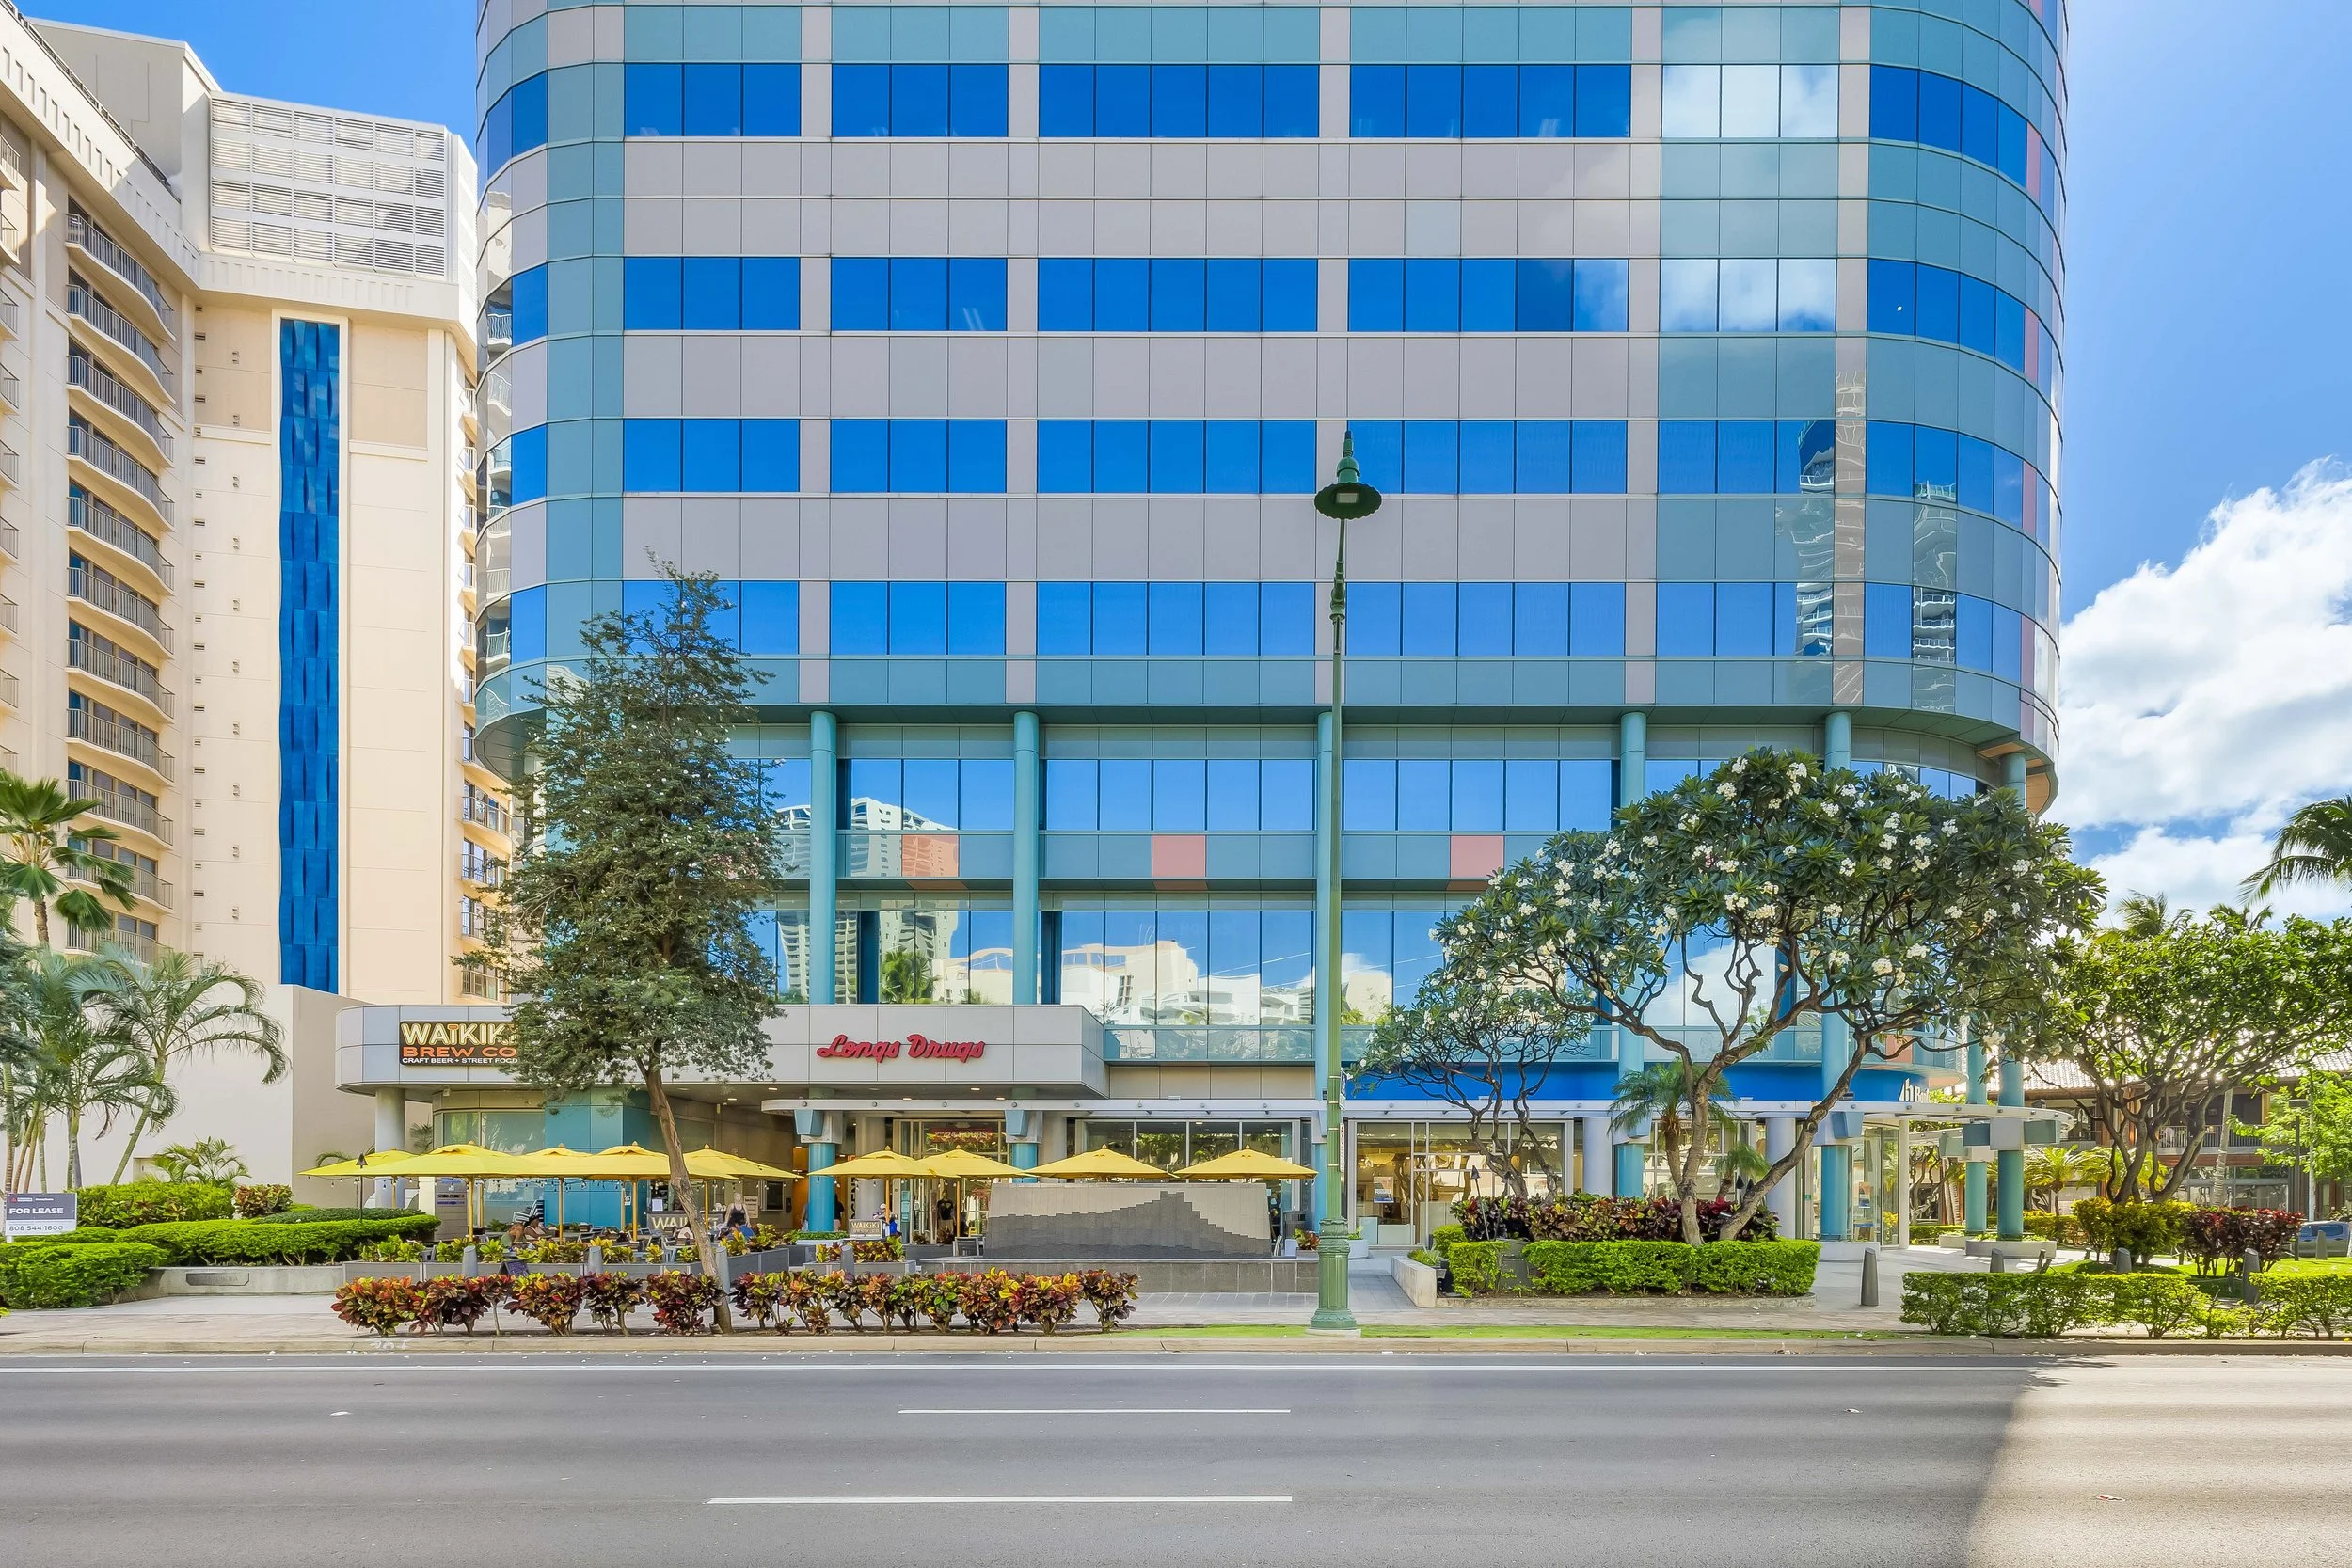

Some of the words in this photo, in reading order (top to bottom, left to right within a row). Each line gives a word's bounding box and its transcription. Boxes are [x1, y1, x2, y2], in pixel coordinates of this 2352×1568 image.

[403, 1046, 475, 1057] BREW
[817, 1034, 901, 1063] Longs
[907, 1034, 986, 1063] Drugs
[959, 1131, 989, 1139] HOURS
